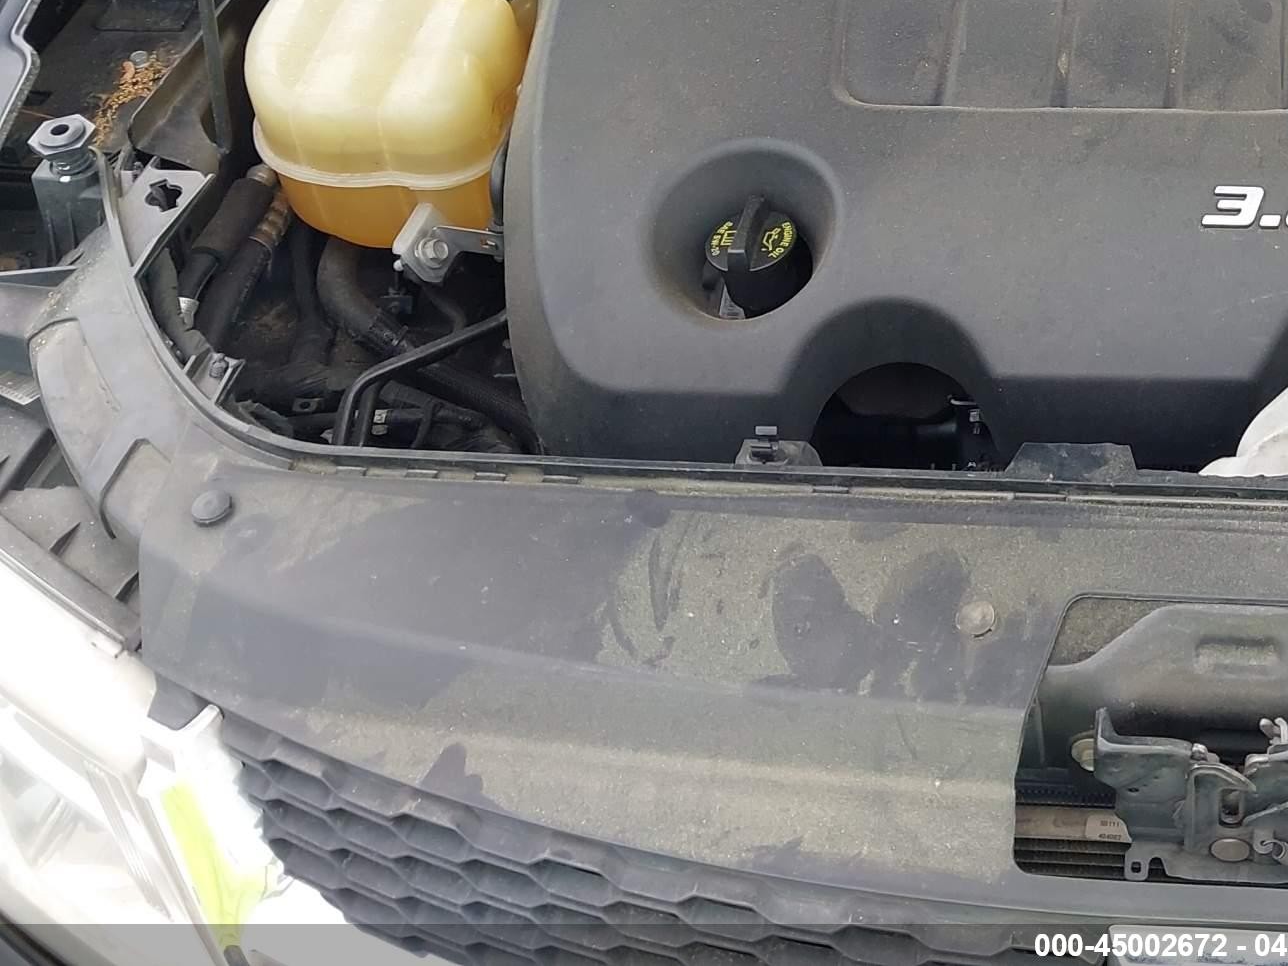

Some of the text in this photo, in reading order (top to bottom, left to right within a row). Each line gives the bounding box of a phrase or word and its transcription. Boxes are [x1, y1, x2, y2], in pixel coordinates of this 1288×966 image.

[711, 221, 733, 256] SAE 5W-20
[768, 222, 793, 259] ENGINE OIL
